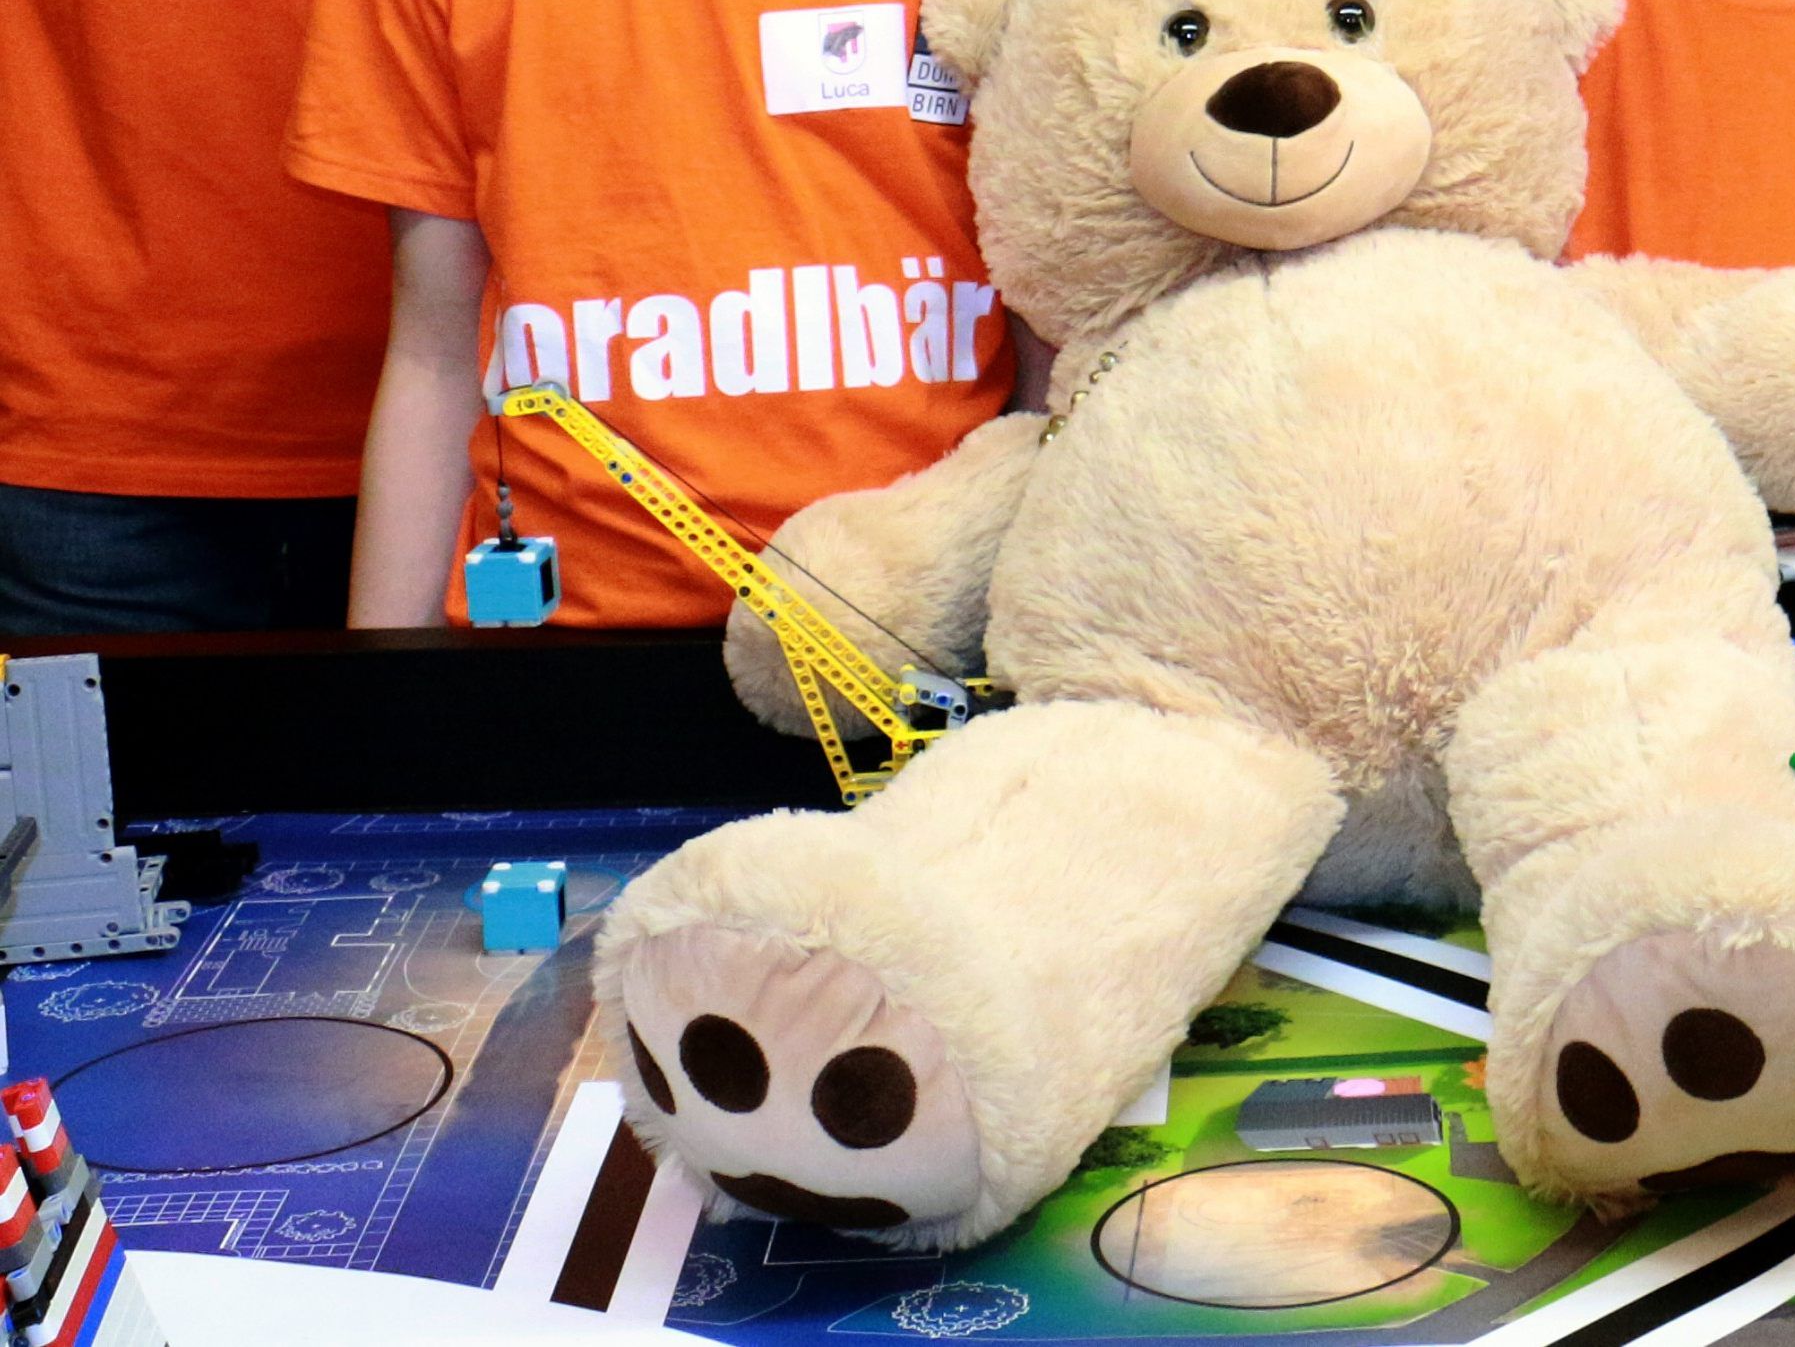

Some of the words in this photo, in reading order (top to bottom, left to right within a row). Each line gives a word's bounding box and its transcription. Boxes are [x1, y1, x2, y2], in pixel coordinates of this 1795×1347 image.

[821, 82, 871, 100] Luca
[911, 92, 958, 118] BIRN
[480, 256, 996, 403] oradlbär
